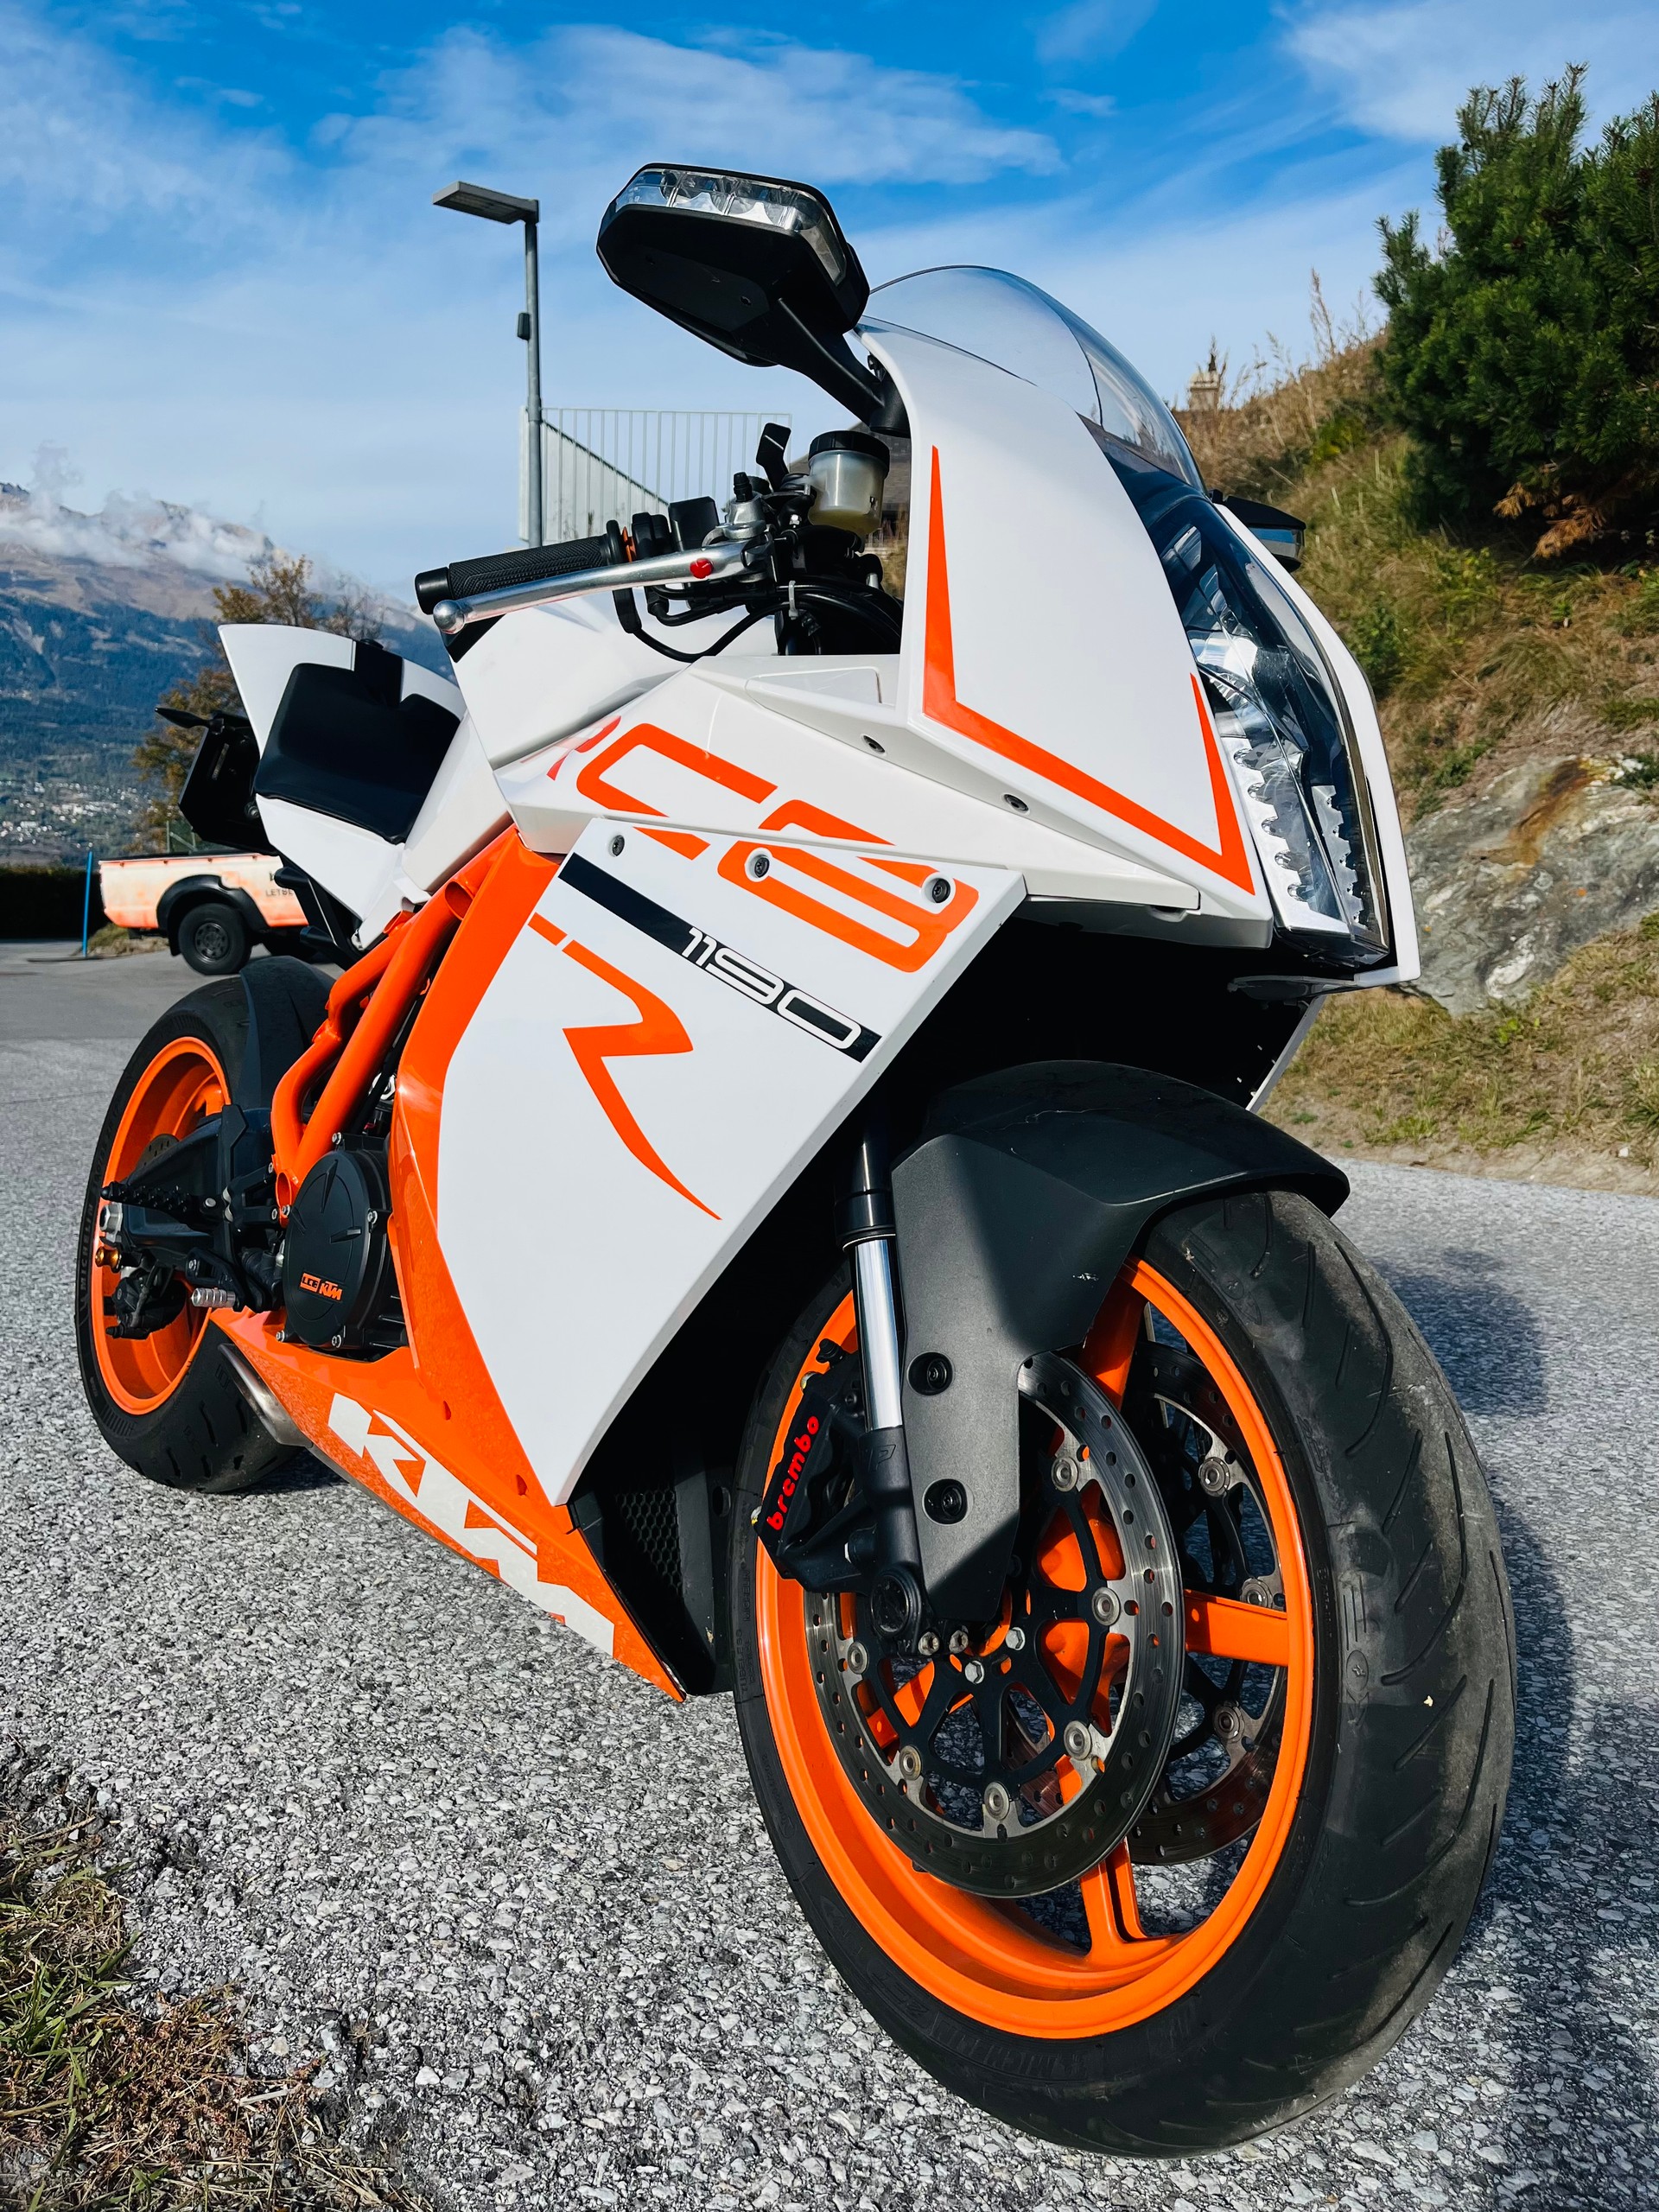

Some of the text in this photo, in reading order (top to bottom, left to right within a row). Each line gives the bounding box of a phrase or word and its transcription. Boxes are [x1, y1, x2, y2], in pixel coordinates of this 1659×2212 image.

[682, 925, 862, 1049] 1190
[319, 1281, 343, 1300] KTM
[327, 1392, 615, 1656] KTM
[766, 1415, 820, 1531] brembo
